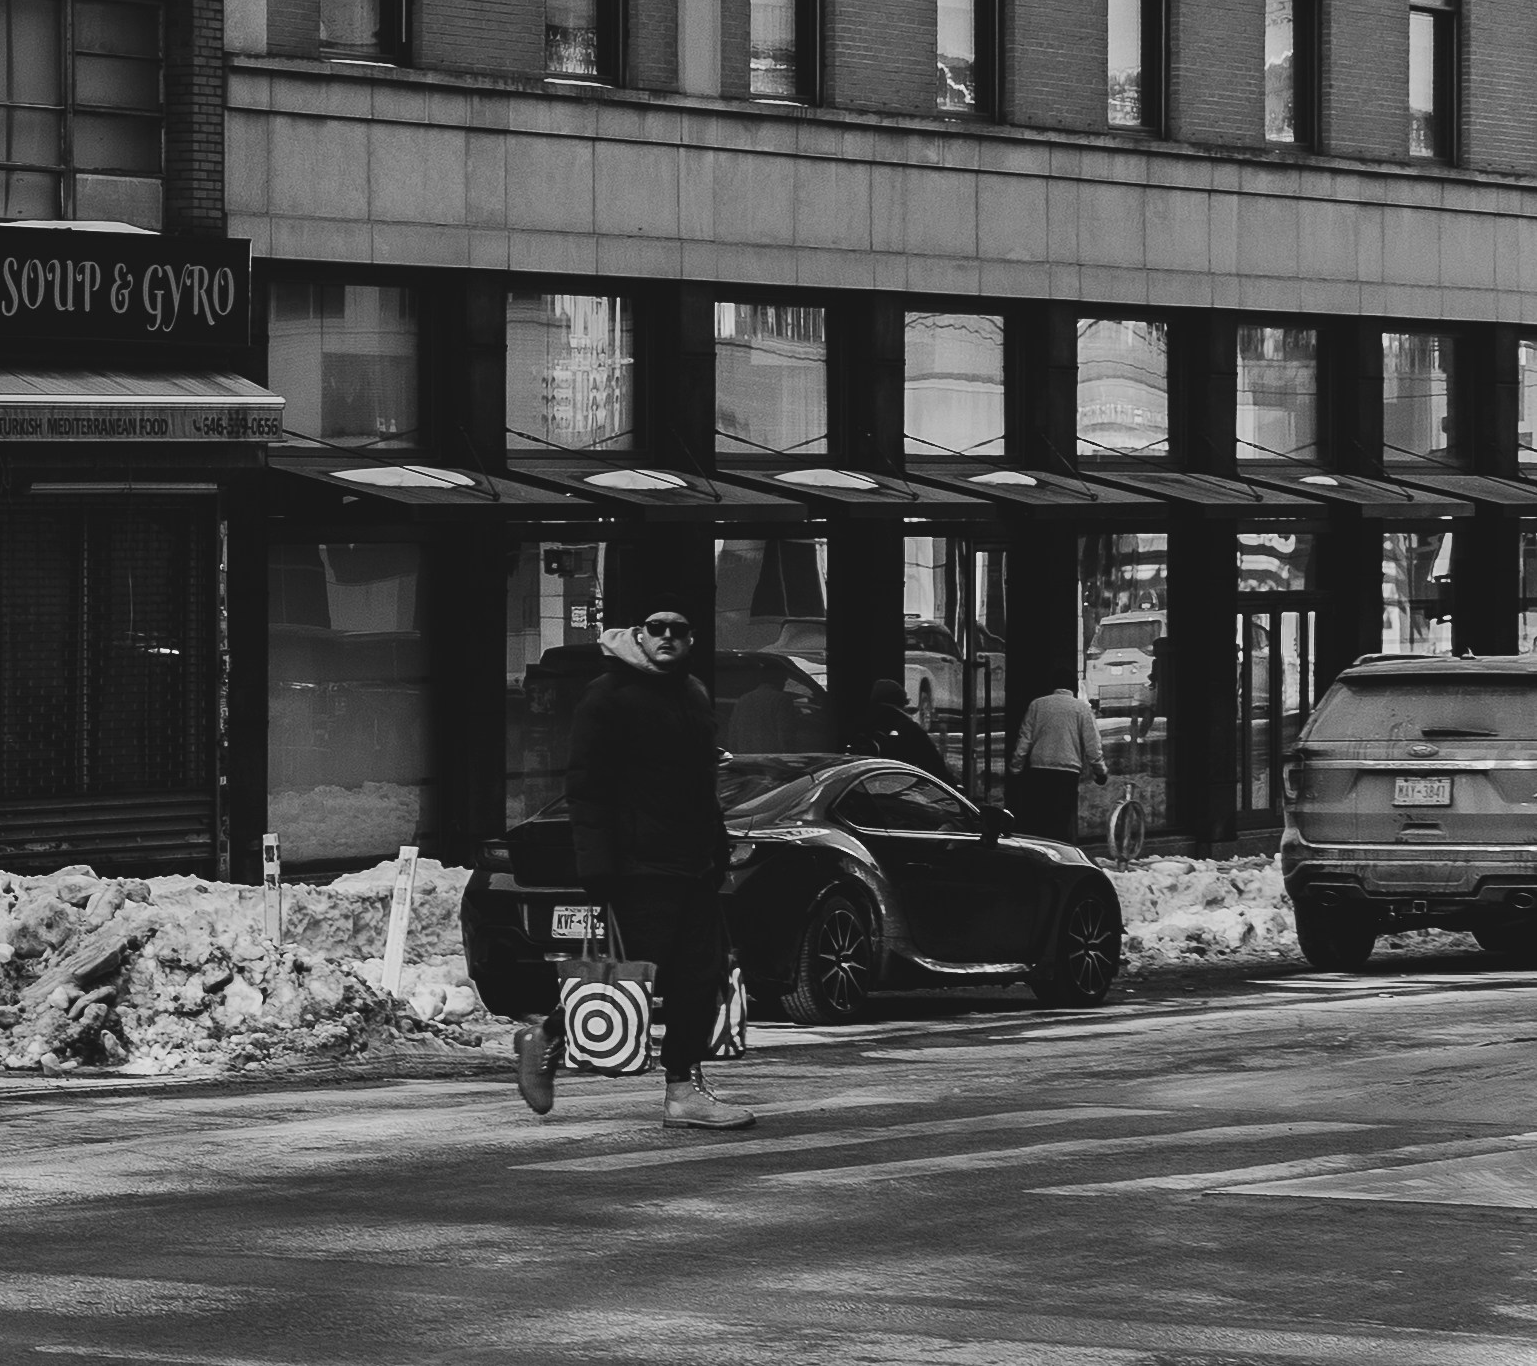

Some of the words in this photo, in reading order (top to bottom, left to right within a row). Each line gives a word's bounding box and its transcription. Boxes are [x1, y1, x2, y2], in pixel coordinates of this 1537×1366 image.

[1, 257, 101, 316] SOUP
[110, 263, 133, 314] &
[142, 263, 235, 332] GYRO
[47, 417, 137, 436] MEDITERRANEAN
[140, 417, 169, 436] FOOD
